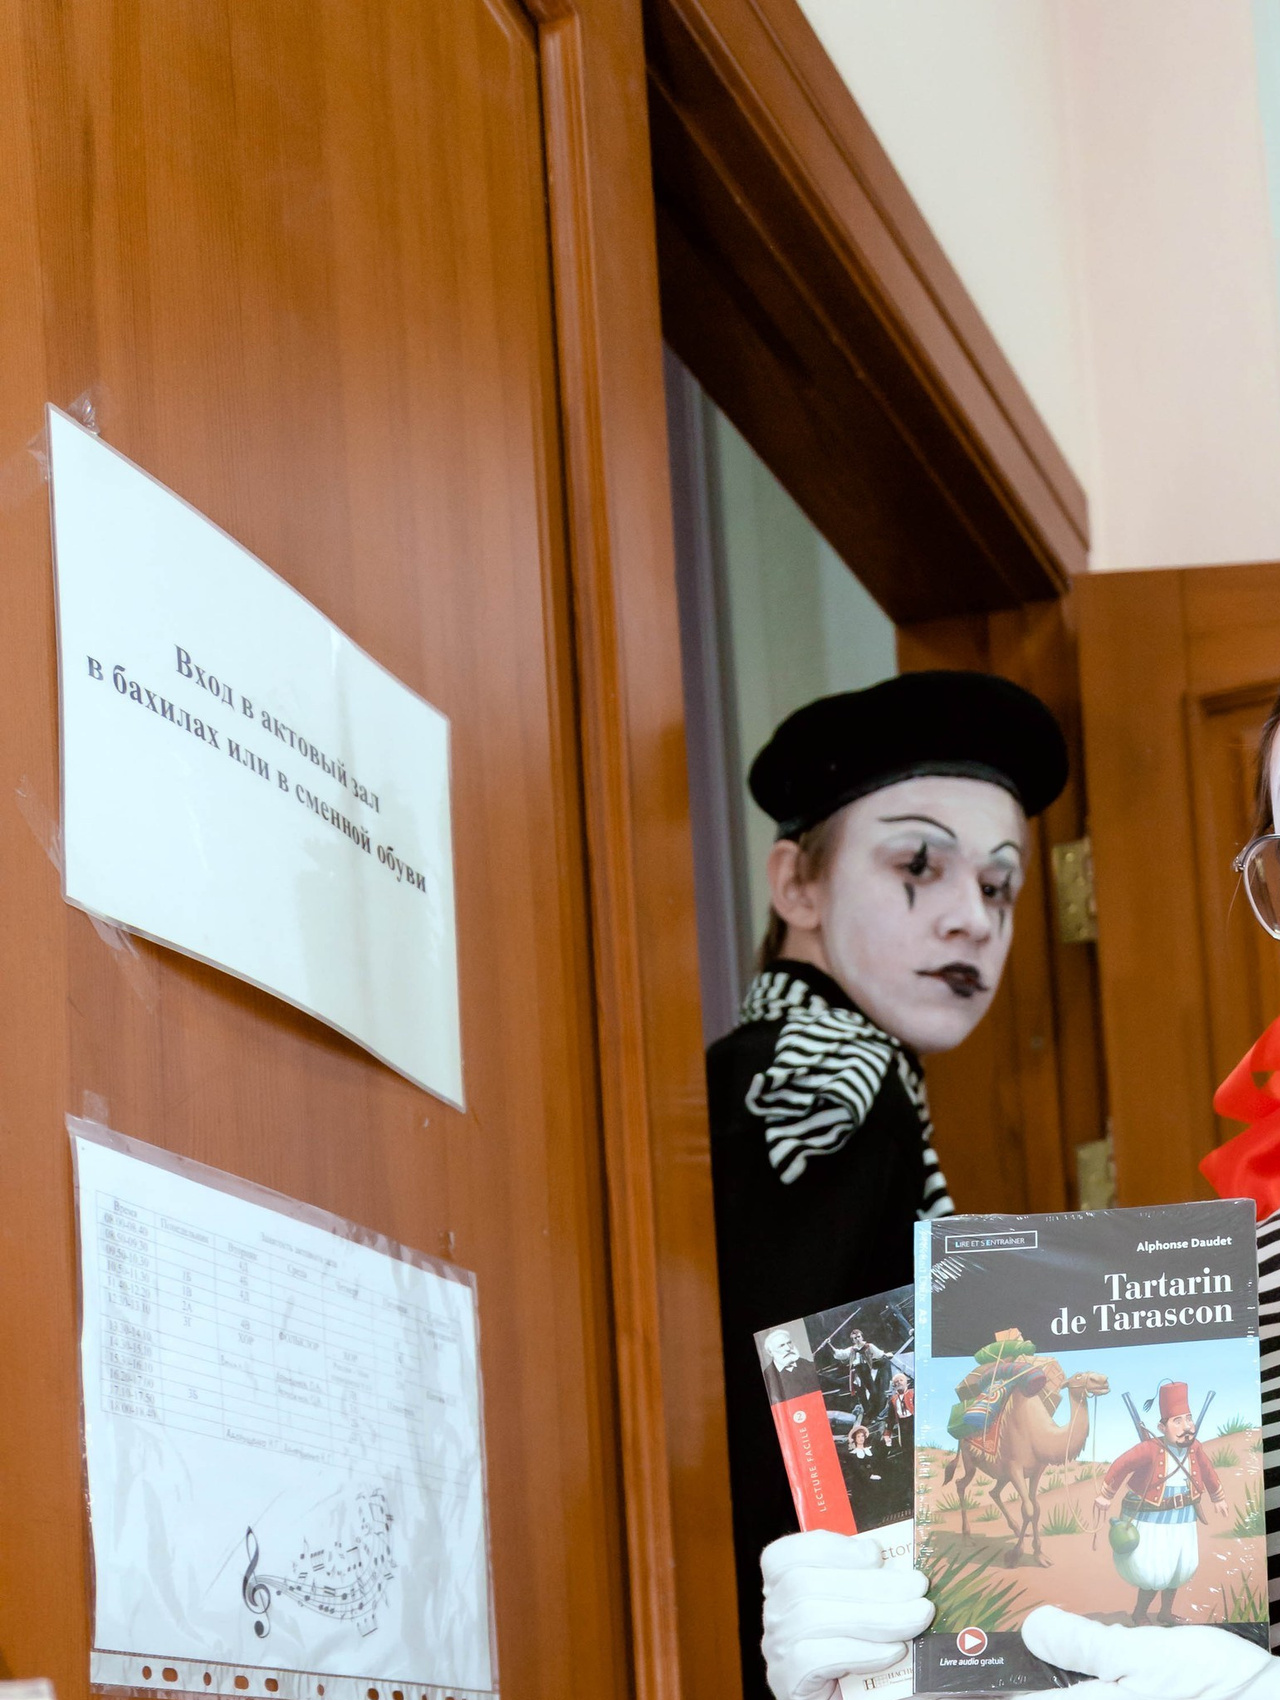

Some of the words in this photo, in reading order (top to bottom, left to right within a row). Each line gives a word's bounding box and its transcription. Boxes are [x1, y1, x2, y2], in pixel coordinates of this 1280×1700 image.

[174, 644, 234, 708] Вход
[242, 695, 254, 719] в
[261, 709, 348, 787] актовый
[352, 776, 381, 814] зал
[86, 655, 104, 682] в
[112, 664, 221, 750] бахилах
[228, 737, 270, 783] или
[278, 770, 290, 794] в
[296, 783, 372, 854] сменной
[377, 844, 427, 893] обуви
[955, 1239, 970, 1248] LIRE
[971, 1239, 980, 1248] ET
[1136, 1239, 1189, 1253] Alphonse
[1190, 1236, 1233, 1249] Daudet
[1104, 1266, 1234, 1302] Tartarin
[1050, 1306, 1087, 1336] de
[1092, 1302, 1234, 1333] Tarascon
[799, 1426, 815, 1462] FACILE
[808, 1466, 827, 1513] LECTURE
[939, 1657, 957, 1667] Livre
[958, 1657, 980, 1667] audio
[980, 1656, 1005, 1668] gratuit
